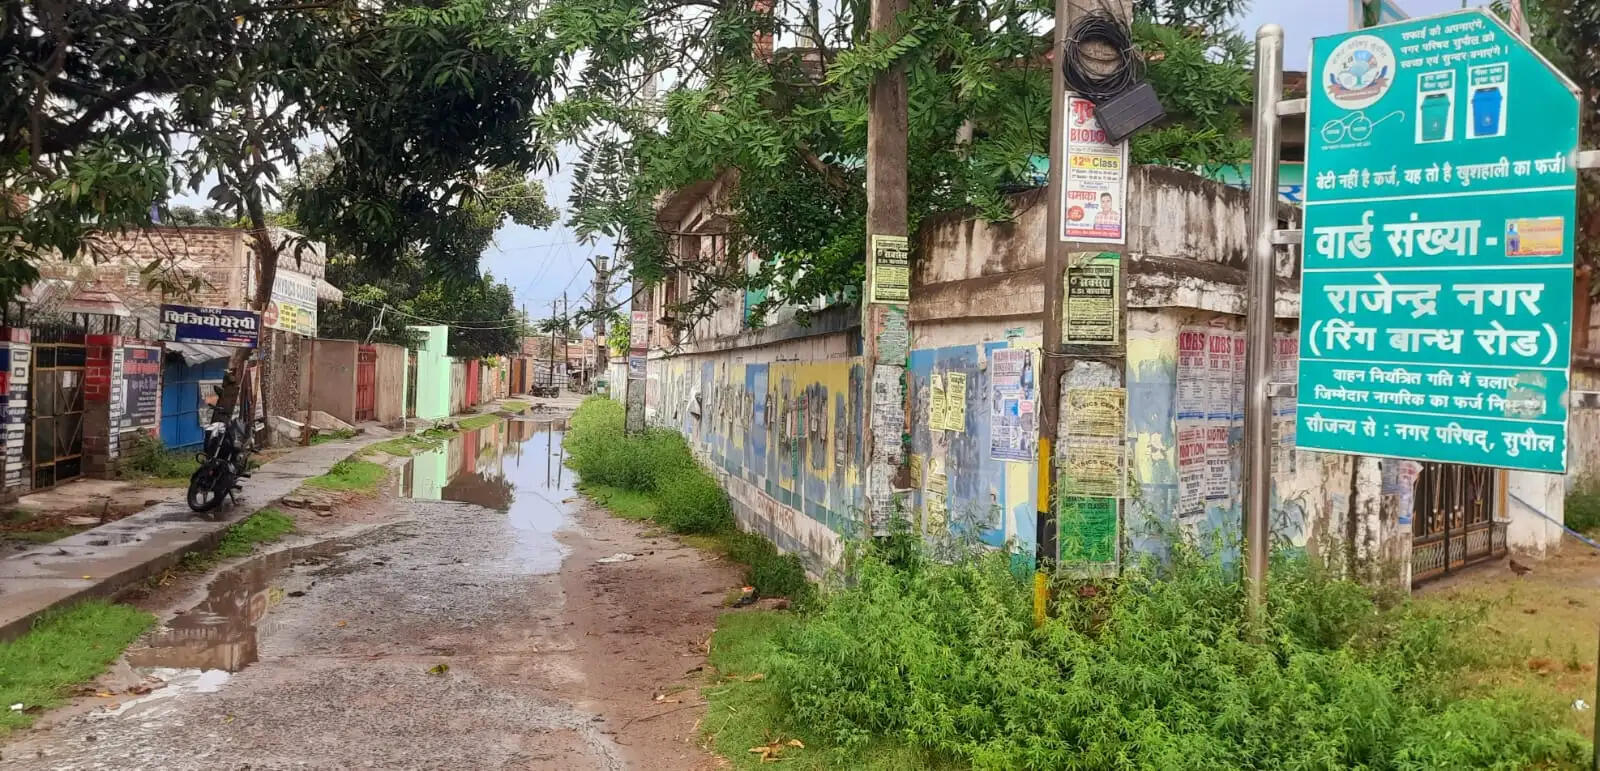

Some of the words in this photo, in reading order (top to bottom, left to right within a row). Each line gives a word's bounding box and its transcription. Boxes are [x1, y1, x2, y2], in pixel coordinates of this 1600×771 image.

[1400, 44, 1420, 55] नगर
[1452, 34, 1480, 51] सुपौल
[1482, 30, 1495, 42] को
[1428, 24, 1441, 36] को
[1070, 128, 1106, 143] BIOLO
[1092, 157, 1118, 168] Class
[1316, 172, 1335, 190] बेटी
[1338, 170, 1360, 189] नहीं
[1362, 167, 1370, 188] है
[1373, 165, 1400, 187] कर्ज,
[1404, 168, 1421, 184] यह
[1425, 162, 1439, 182] तो
[1443, 161, 1452, 181] है
[1456, 157, 1509, 186] खुशहाली
[1513, 159, 1530, 176] का
[1313, 210, 1374, 260] वार्ड
[1323, 272, 1441, 319] राजेन्द्र
[1453, 283, 1545, 316] नगर
[165, 311, 256, 330] फिजियोथेरेपी
[1309, 318, 1377, 356] (रिंग
[1387, 328, 1464, 354] बान्ध
[1474, 320, 1558, 365] रोड)
[1333, 368, 1365, 382] वाहन
[1369, 366, 1422, 386] नियंत्रित
[1428, 368, 1453, 387] गति
[1459, 371, 1472, 389] में
[1314, 385, 1369, 403] जिम्मेदार
[1374, 389, 1425, 408] नागरिक
[1430, 395, 1448, 409] का
[1454, 392, 1483, 411] फर्ज
[1305, 412, 1355, 434] सौजन्य
[1362, 417, 1376, 437] से
[1394, 423, 1428, 441] नगर
[1501, 427, 1555, 457] सुपौल
